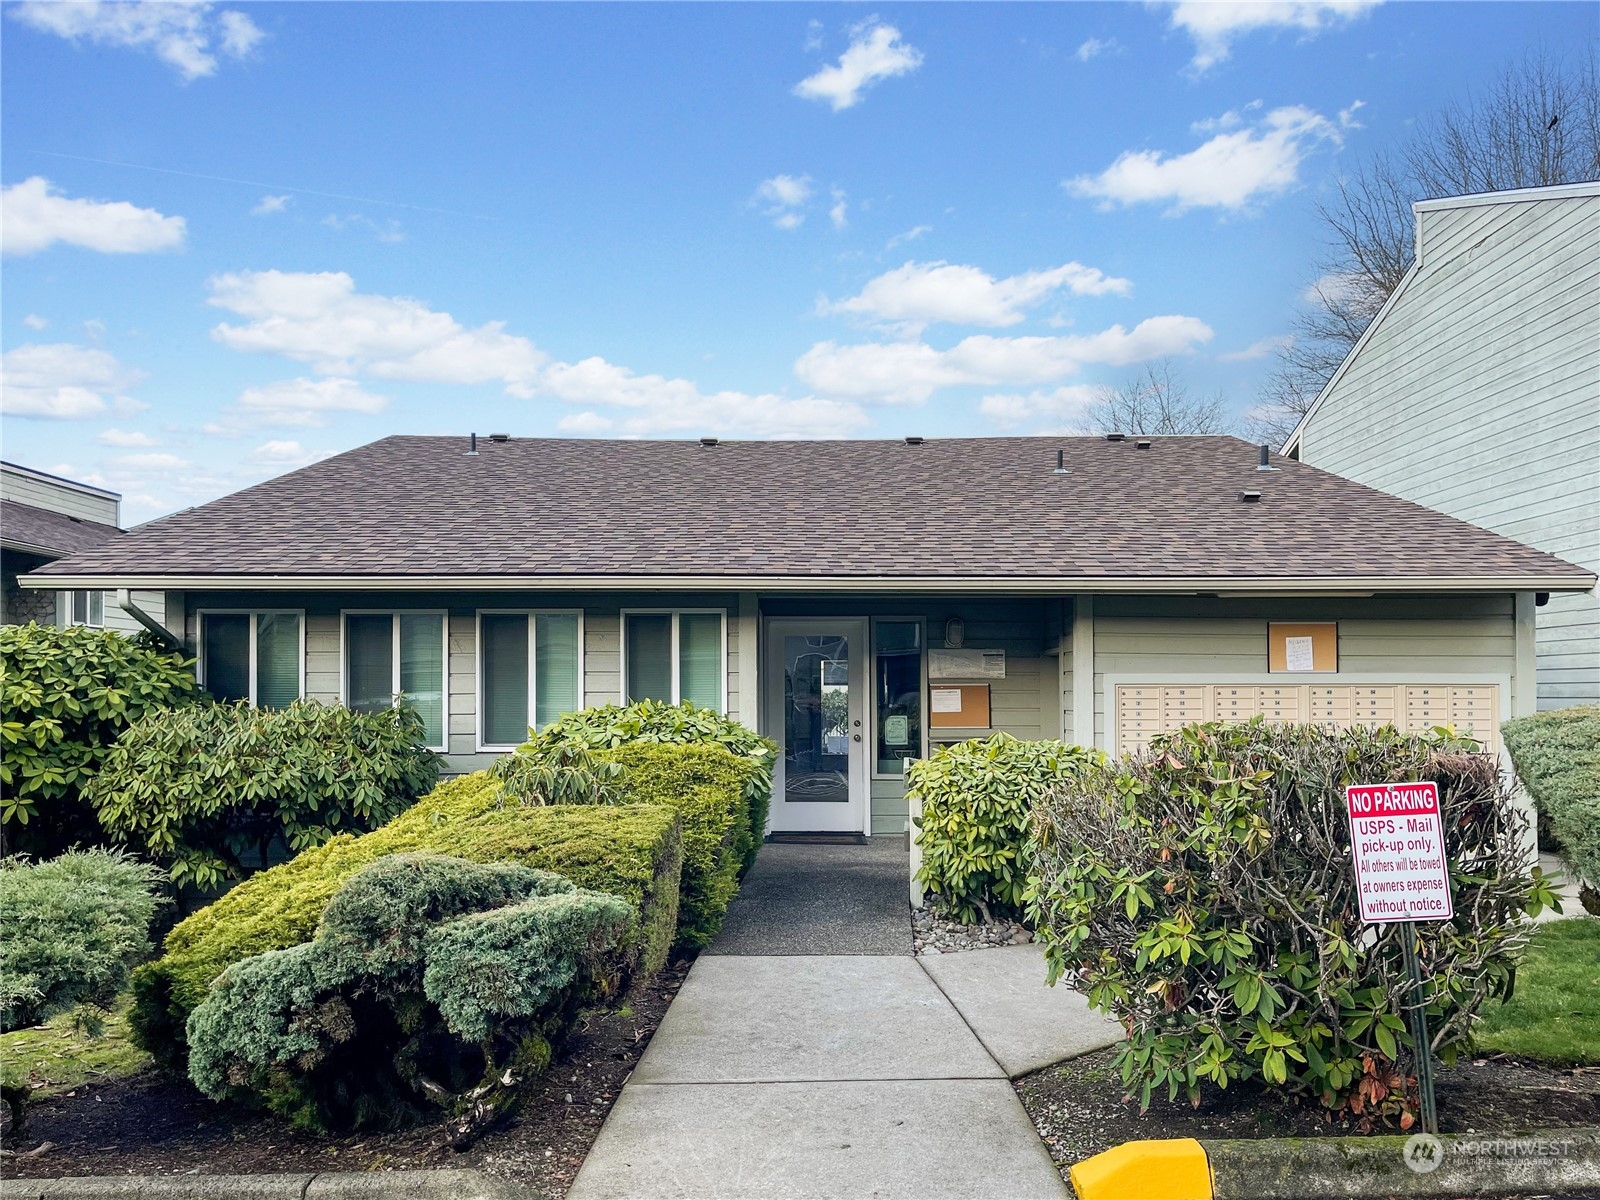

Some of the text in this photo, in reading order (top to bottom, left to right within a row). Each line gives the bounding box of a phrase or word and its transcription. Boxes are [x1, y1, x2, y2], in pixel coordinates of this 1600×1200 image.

[1351, 789, 1434, 813] NO PARKING
[1359, 819, 1395, 835] USPS
[1407, 818, 1433, 833] Mail
[1362, 836, 1435, 856] pick-up only.
[1361, 856, 1441, 873] All others will be towed
[1363, 879, 1443, 893] at owners expense
[1367, 897, 1445, 914] without notice.
